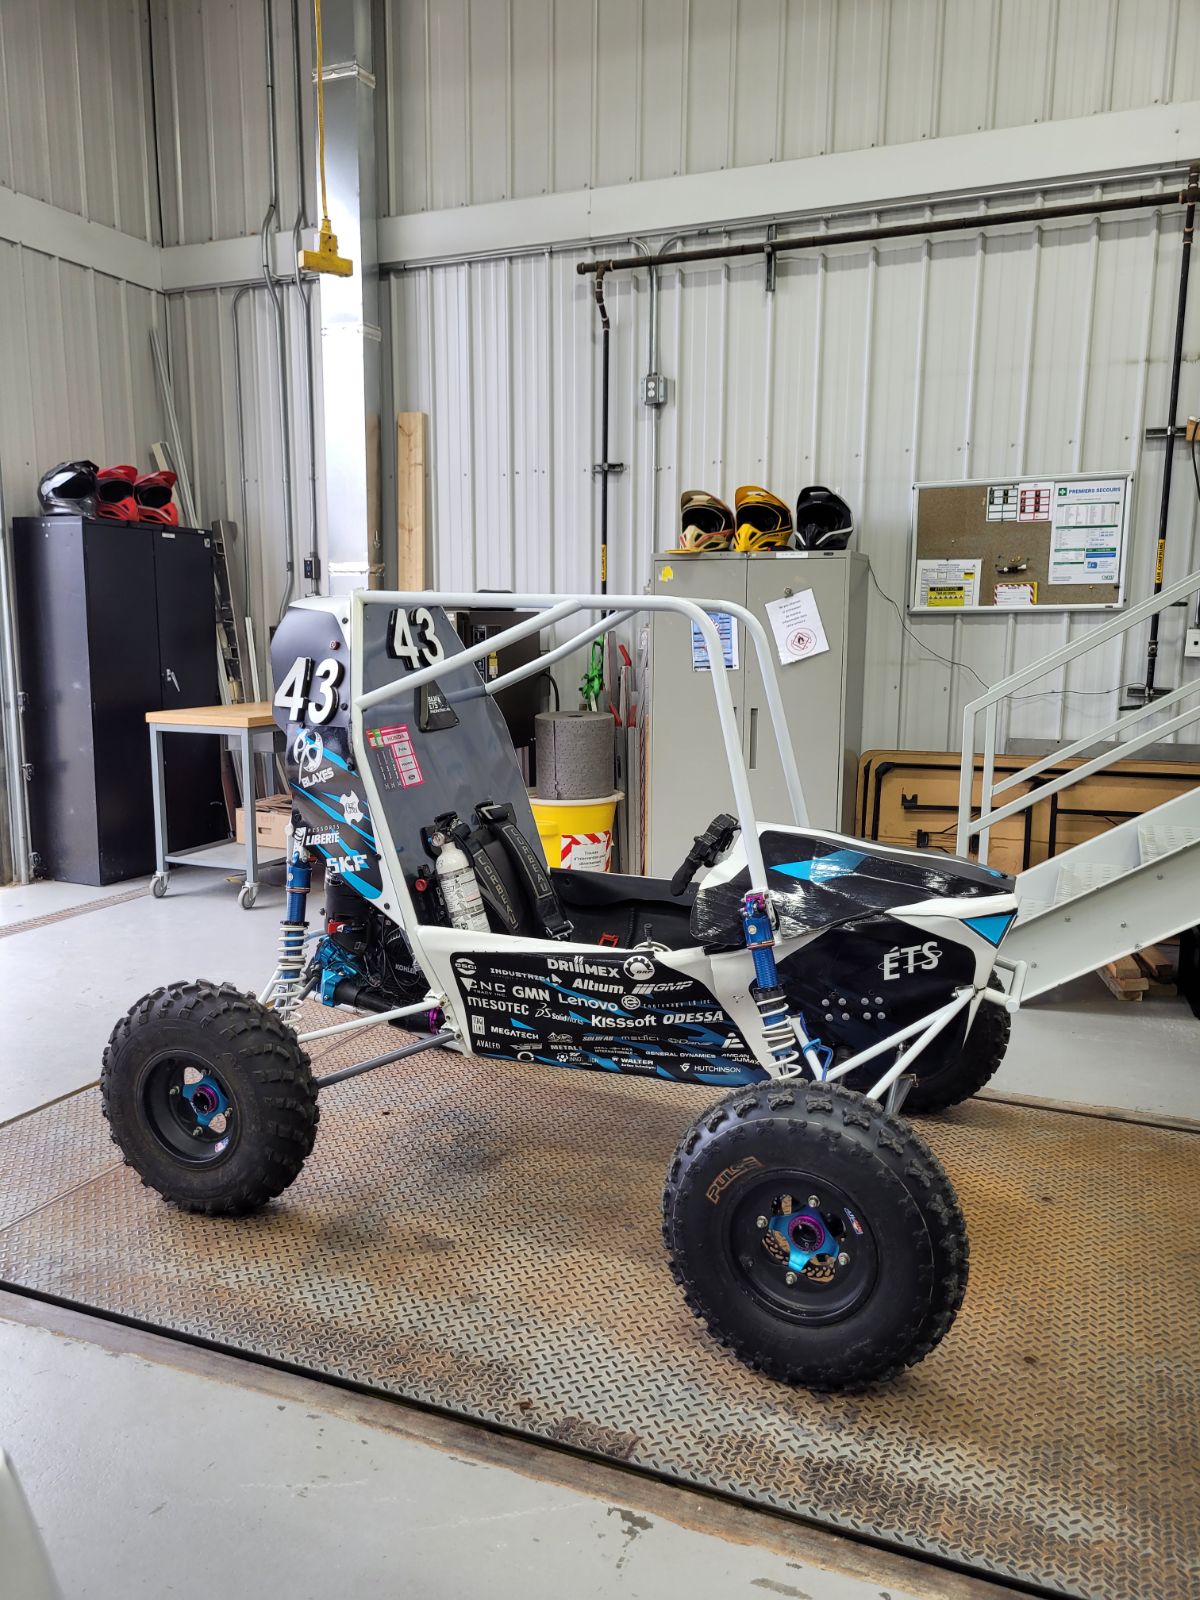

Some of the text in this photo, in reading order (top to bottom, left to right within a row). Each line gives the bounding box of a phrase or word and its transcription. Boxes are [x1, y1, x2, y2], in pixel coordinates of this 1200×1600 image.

[392, 607, 444, 668] 43
[274, 656, 341, 725] 43
[301, 767, 335, 789] BLAXES
[306, 831, 340, 845] LIBERTÉ
[326, 854, 368, 873] SKF
[510, 828, 548, 892] CORBEAU
[478, 856, 517, 925] CORBEAU
[883, 941, 939, 980] ÉTS
[512, 985, 551, 1002] GMN
[558, 993, 619, 1012] Lenovo
[663, 1011, 724, 1025] ODESSA
[490, 1025, 539, 1040] MEGATECH
[620, 1057, 654, 1065] WALTER
[694, 1065, 741, 1073] HUTCHINSON
